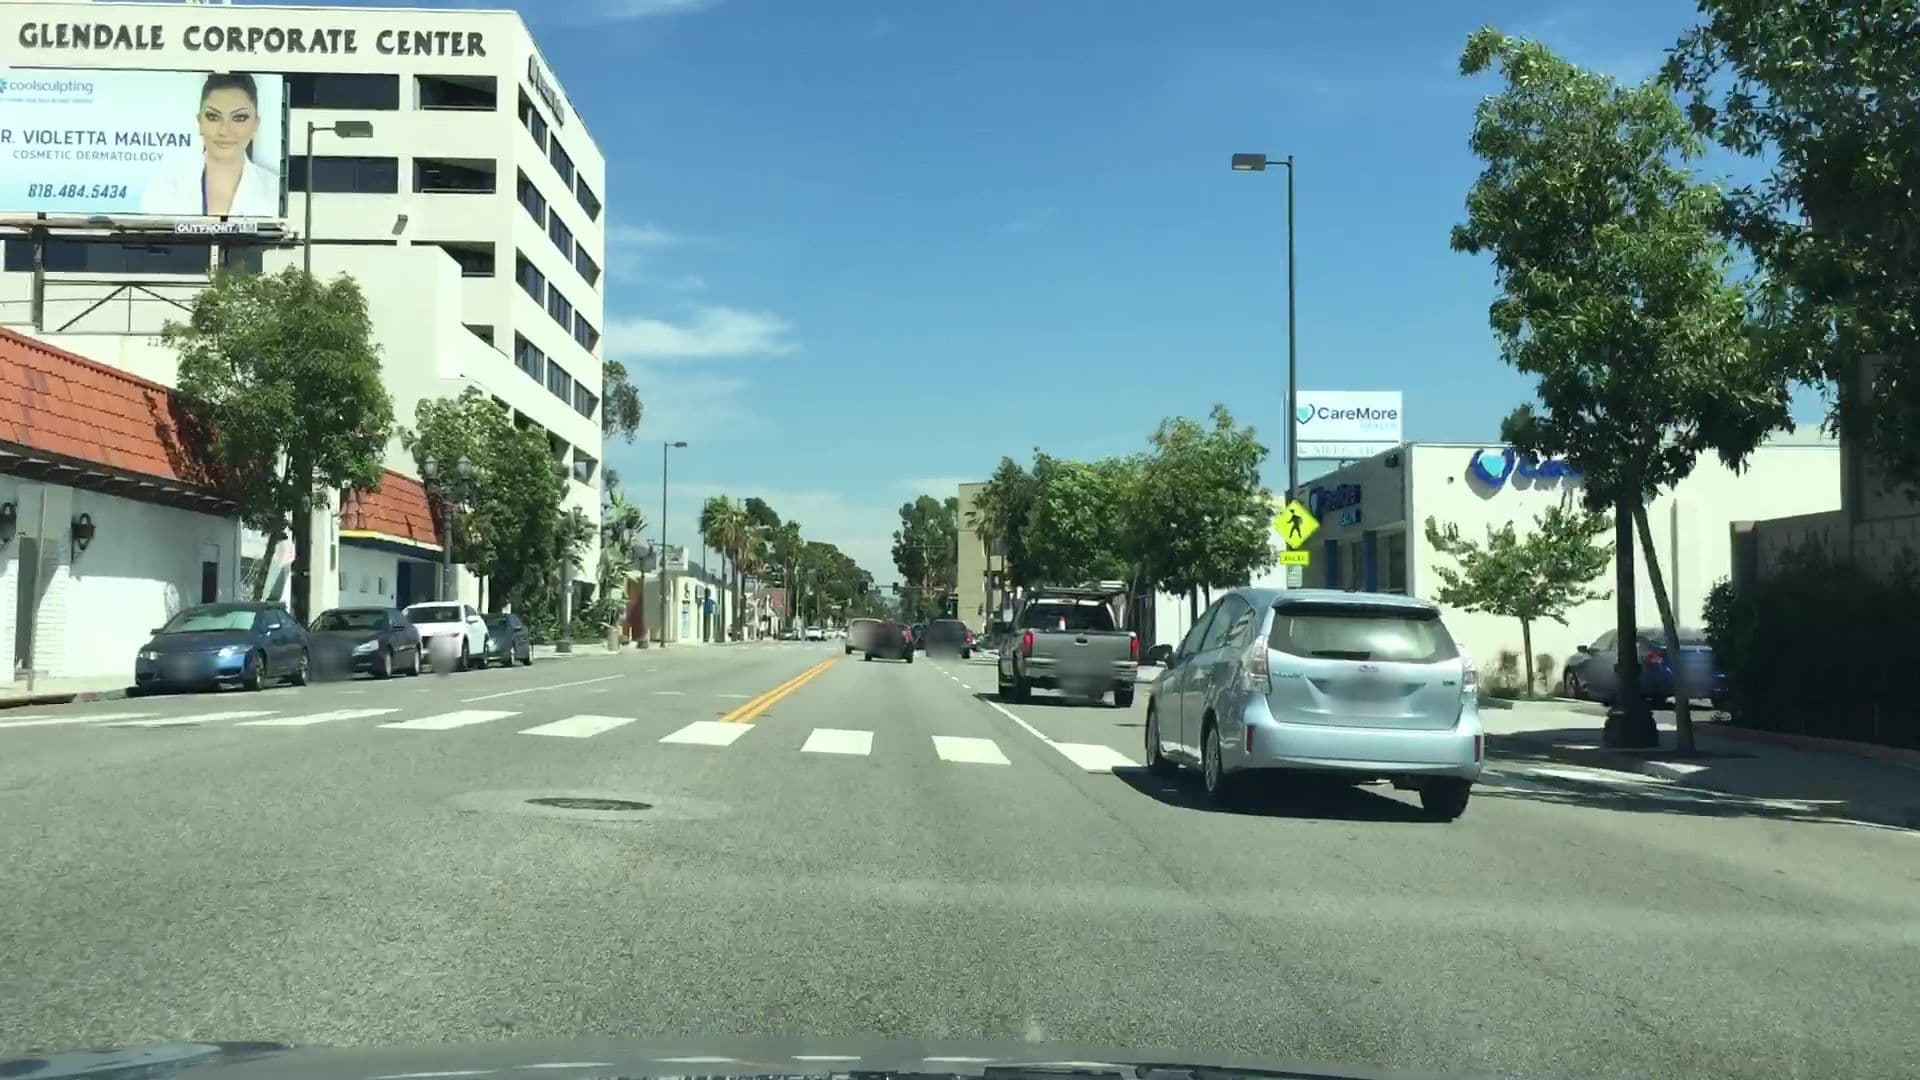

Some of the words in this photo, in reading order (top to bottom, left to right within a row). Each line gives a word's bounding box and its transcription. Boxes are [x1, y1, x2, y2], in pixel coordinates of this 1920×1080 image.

[19, 22, 165, 50] GLENDALE
[183, 25, 358, 54] CORPORATE
[376, 29, 487, 57] CENTER
[9, 80, 94, 95] coolsculpting
[23, 130, 108, 145] VIOLETTA
[115, 131, 192, 147] MAILYAN
[13, 150, 71, 160] COSMETIC
[76, 151, 164, 161] DERMATOLOGY
[28, 183, 128, 199] 818.484.5434
[1317, 407, 1398, 420] CareMore
